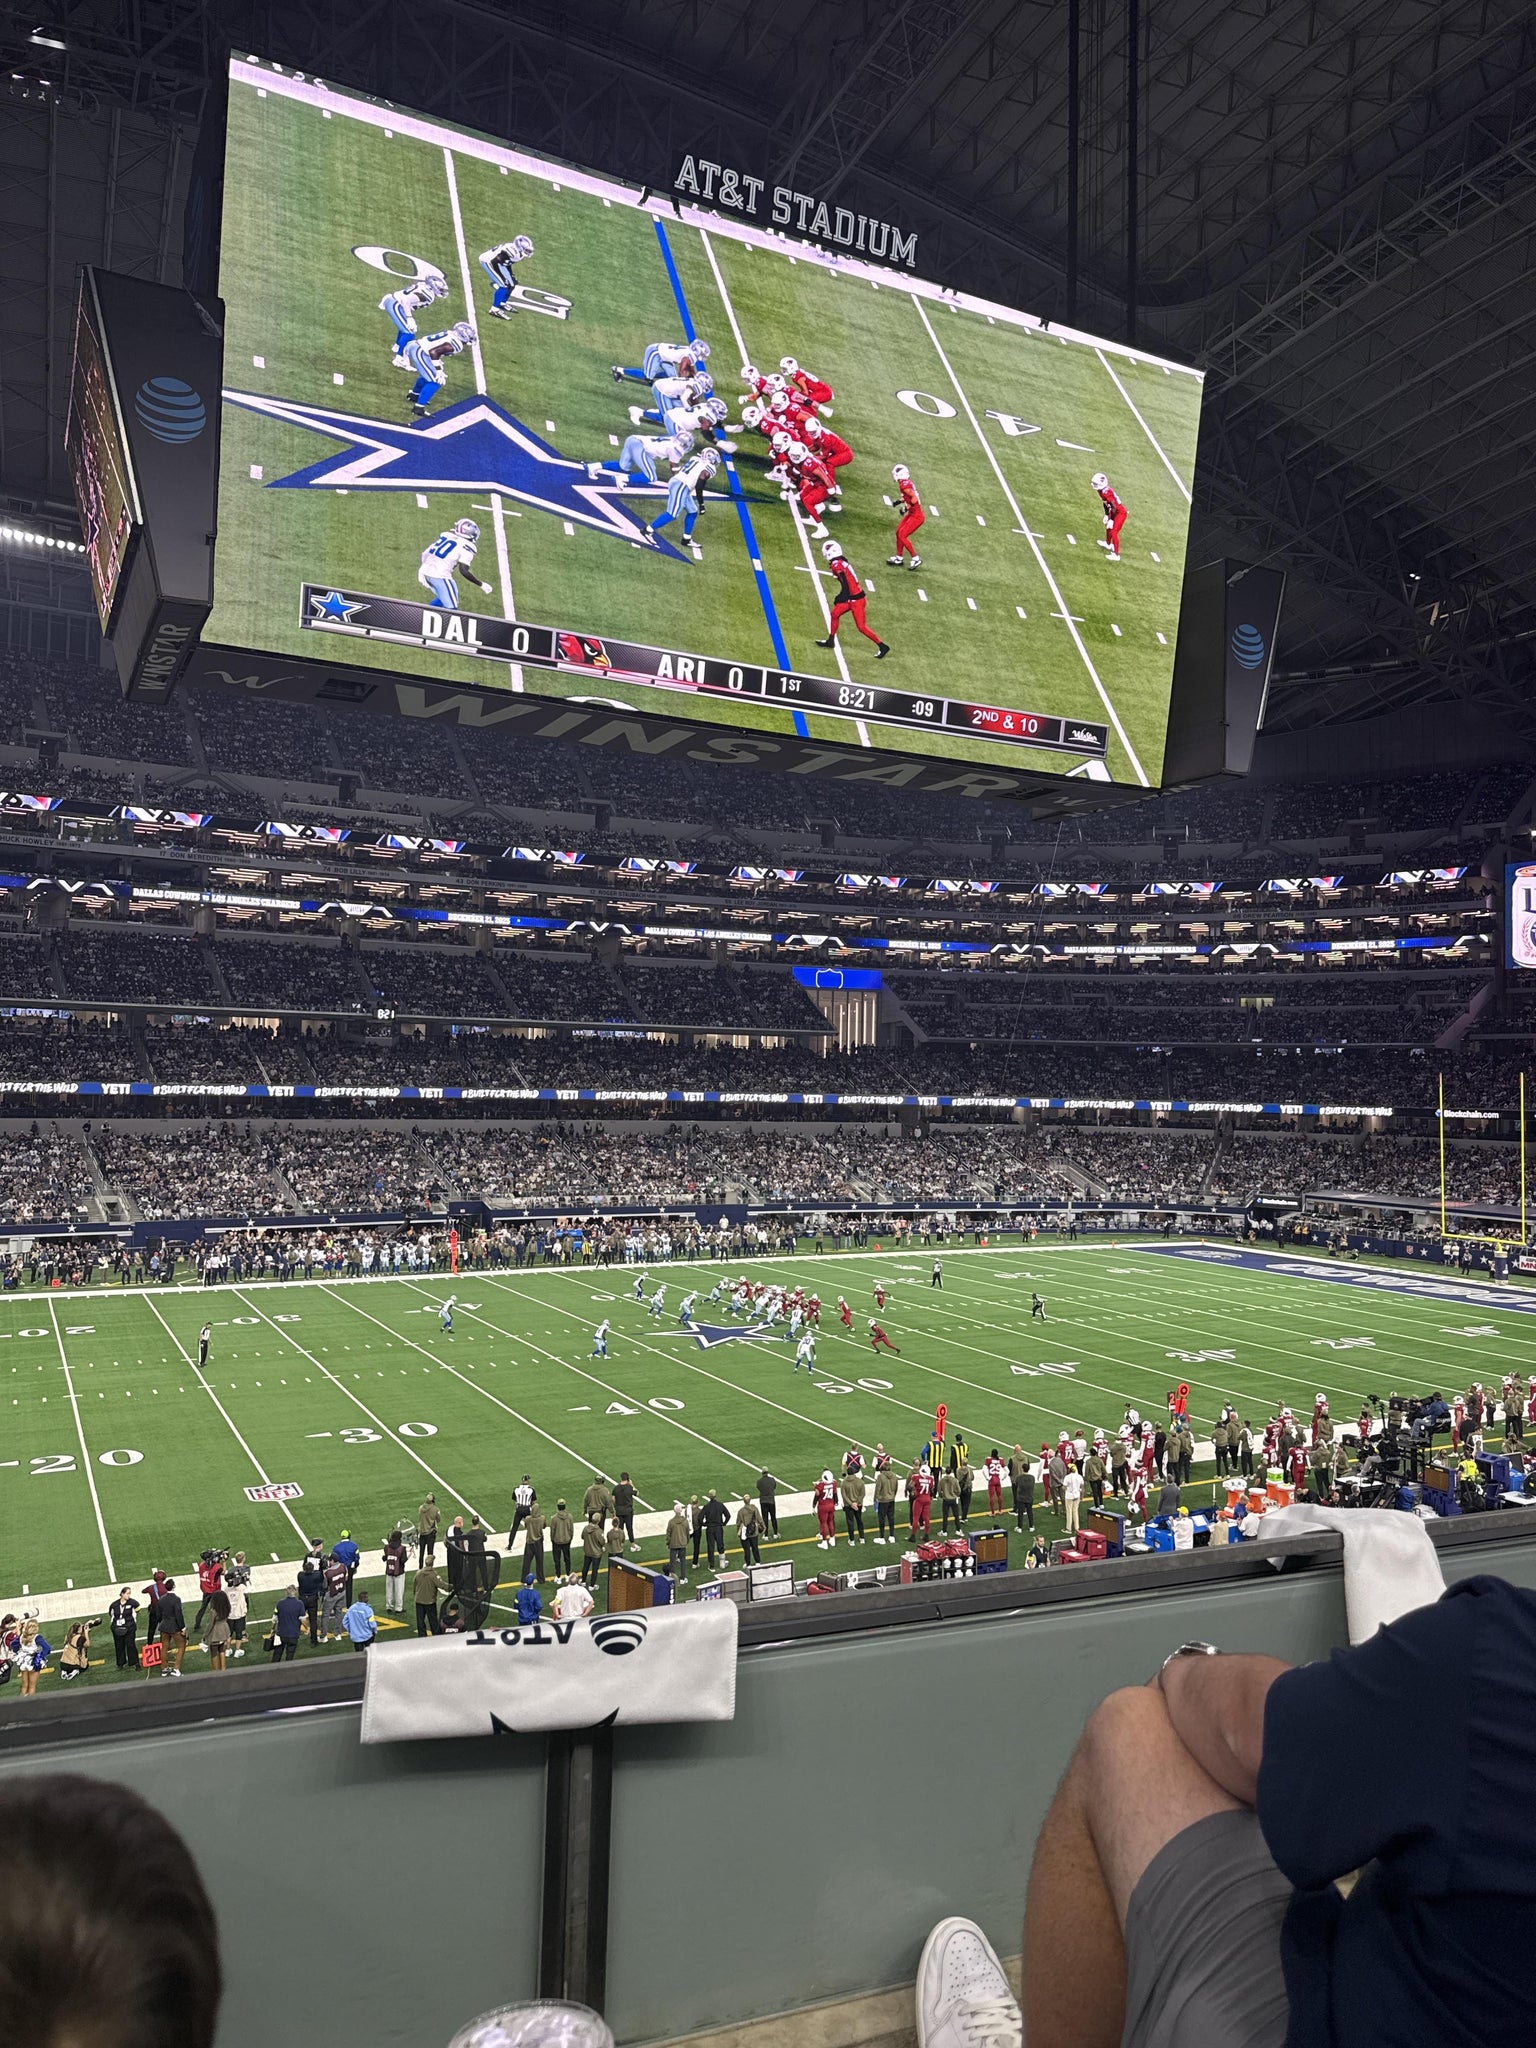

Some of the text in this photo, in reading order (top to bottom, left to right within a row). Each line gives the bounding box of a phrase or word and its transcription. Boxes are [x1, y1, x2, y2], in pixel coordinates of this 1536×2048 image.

[674, 155, 918, 267] AT&T STADIUM
[138, 623, 191, 690] WINSTAR
[422, 610, 482, 646] DAL
[512, 628, 529, 654] 0
[657, 654, 705, 684] ARI
[728, 667, 743, 691] 0
[779, 676, 802, 694] 1ST
[838, 686, 875, 710] 8:21
[911, 700, 934, 717] :09
[972, 709, 999, 725] 2ND
[1003, 715, 1014, 730] &
[1020, 718, 1038, 734] 10
[395, 684, 1021, 798] WINSTAR
[22, 837, 54, 846] HOWLEY
[187, 853, 223, 862] MEREDITH
[133, 888, 164, 898] DALLAS
[164, 891, 200, 901] COWBOYS
[211, 894, 226, 903] LOS
[226, 896, 261, 907] ANGELES
[261, 899, 300, 909] CHARGERS
[447, 913, 484, 924] DECEMBER
[645, 927, 668, 935] DALLAS
[668, 928, 695, 937] COWBOYS
[704, 930, 715, 938] LOS
[102, 1083, 130, 1094] YETI
[267, 1086, 294, 1096] YETI
[419, 1088, 443, 1098] YETI
[556, 1090, 578, 1099] YETI
[683, 1092, 704, 1101] YETI
[803, 1094, 823, 1103] YETI
[918, 1097, 937, 1106] YETI
[1030, 1099, 1049, 1109] YETI
[1150, 1102, 1172, 1112] YETI
[1280, 1105, 1303, 1114] YETI
[1444, 1110, 1499, 1121] Blockchain.com
[1009, 1361, 1077, 1377] 40
[812, 1377, 895, 1396] 50
[604, 1396, 687, 1416] 40
[338, 1421, 440, 1444] 30
[28, 1448, 145, 1475] 20
[1297, 1454, 1304, 1465] 3
[989, 1463, 1001, 1475] 29
[920, 1483, 930, 1495] 71
[256, 1490, 296, 1500] NFL
[145, 1646, 162, 1665] 20
